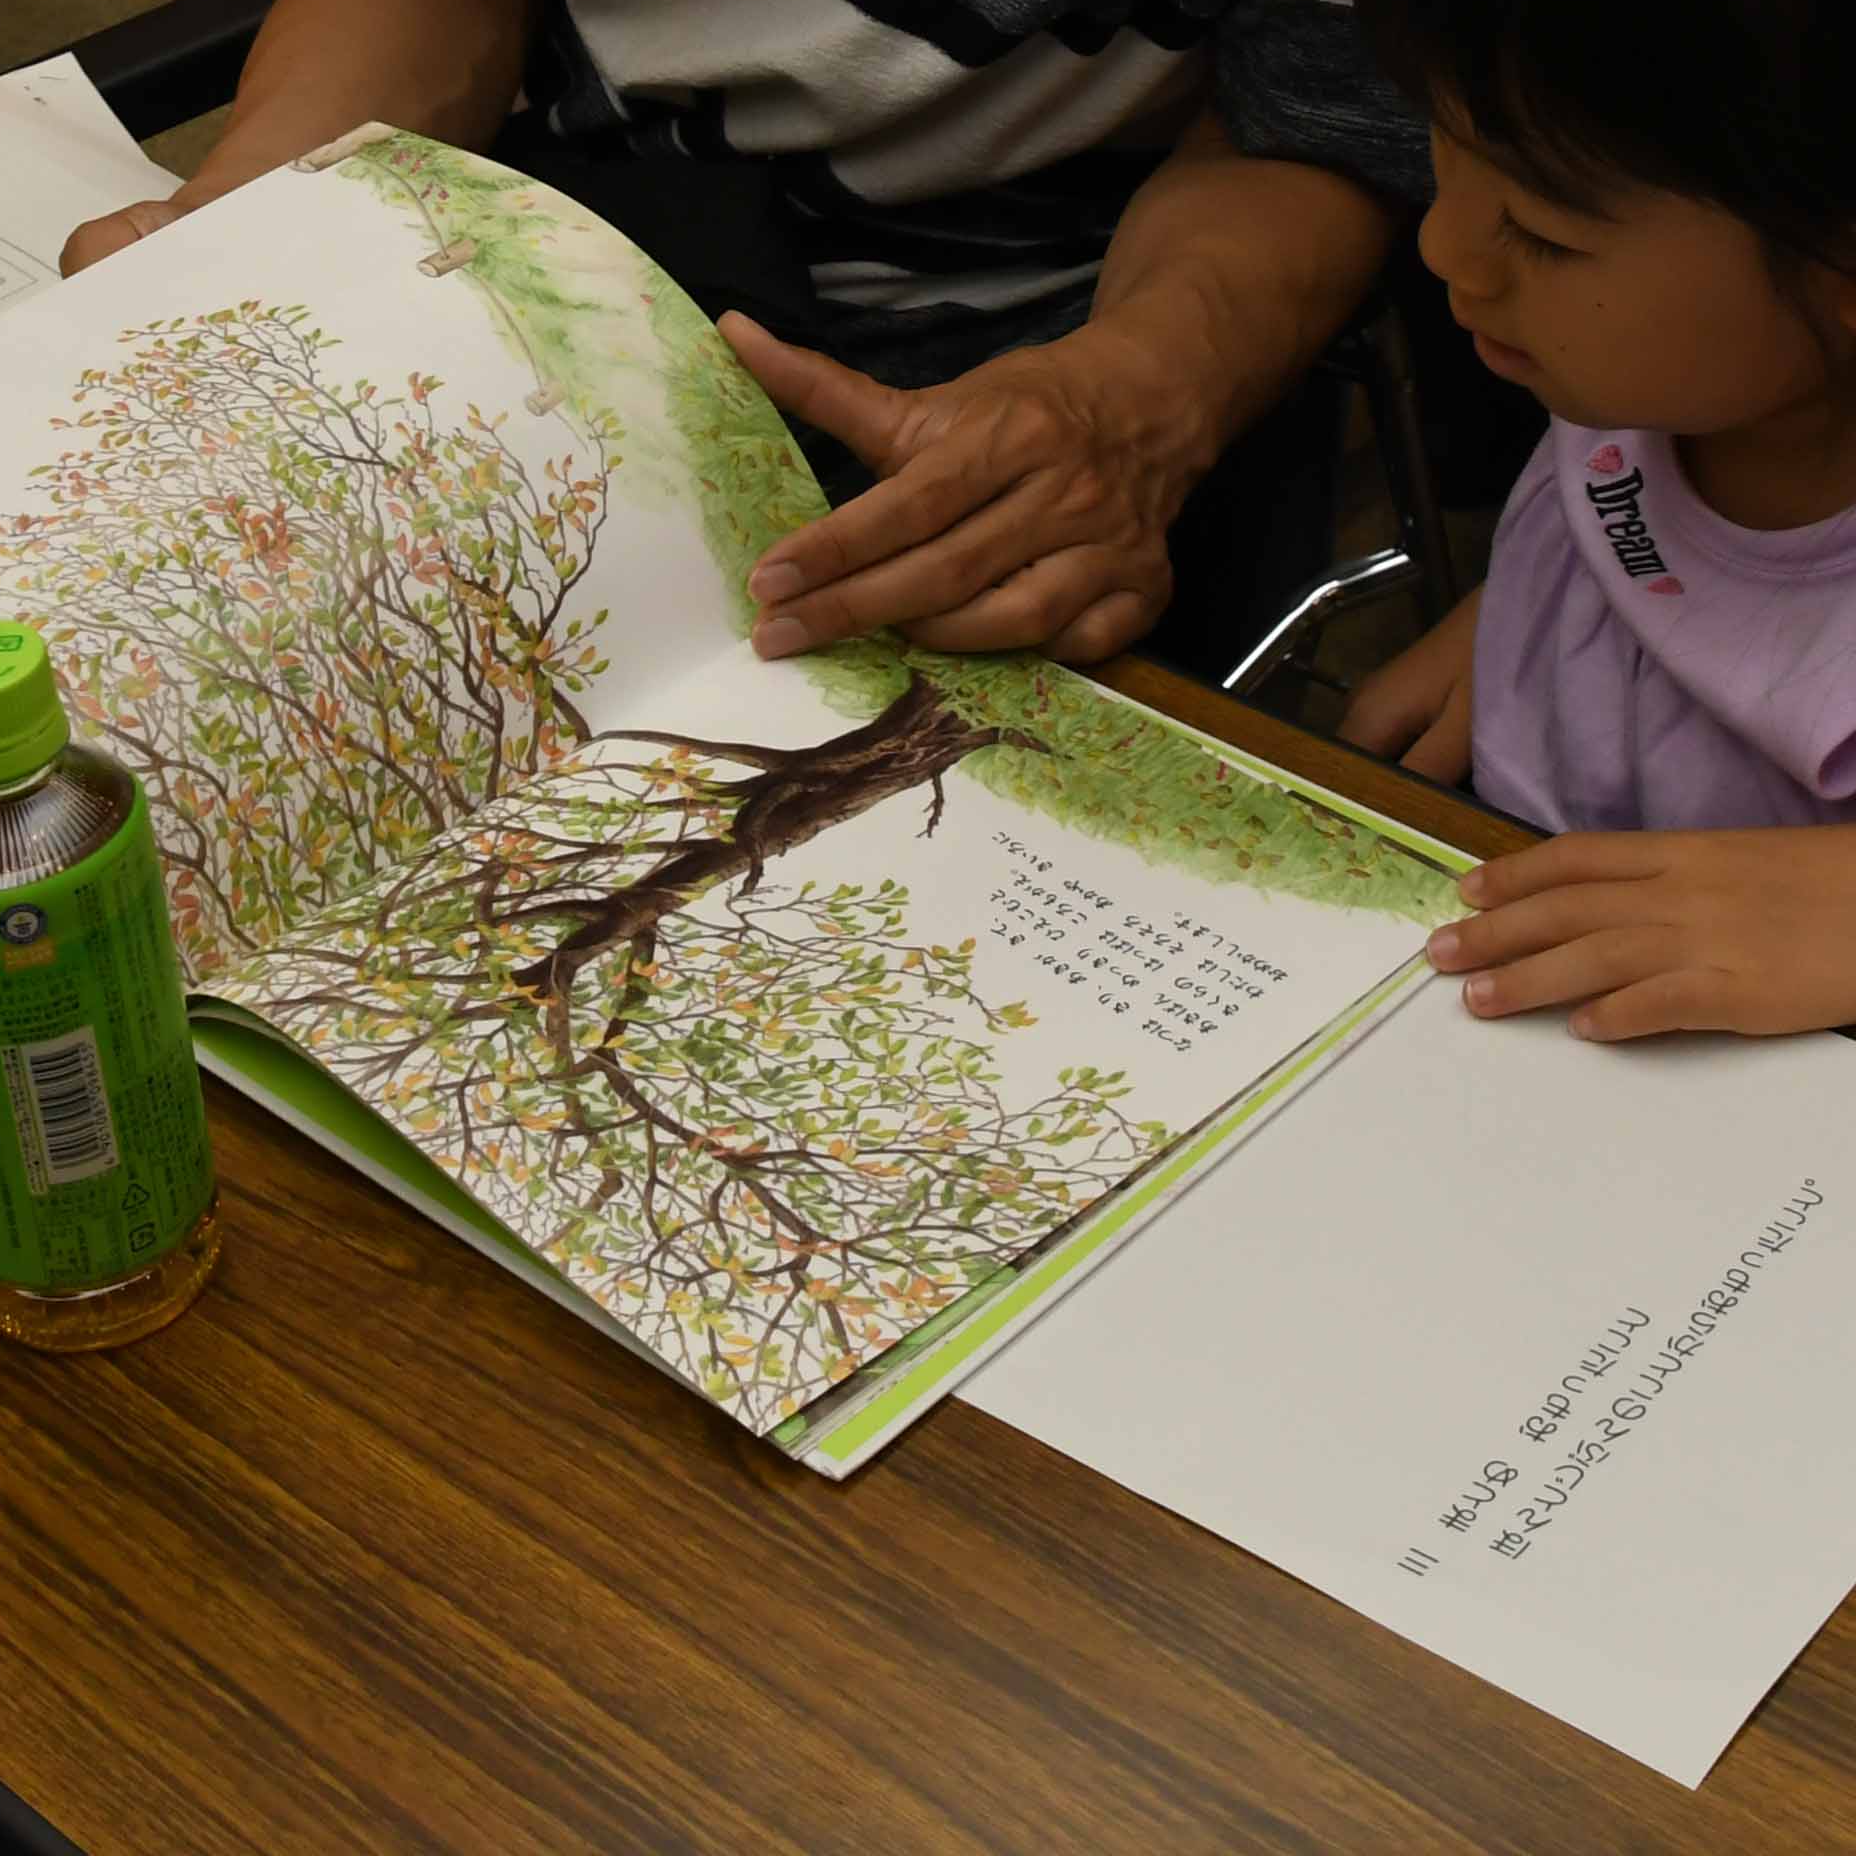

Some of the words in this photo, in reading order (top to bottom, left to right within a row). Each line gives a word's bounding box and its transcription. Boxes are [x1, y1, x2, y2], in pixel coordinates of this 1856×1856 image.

[1586, 466, 1667, 578] Dream
[1396, 1547, 1440, 1577] 三
[1438, 1460, 1519, 1533] まとめ
[1518, 1307, 1651, 1443] おもったこと
[1488, 1178, 1824, 1560] ほんとじぶんのことからおもったこと。
